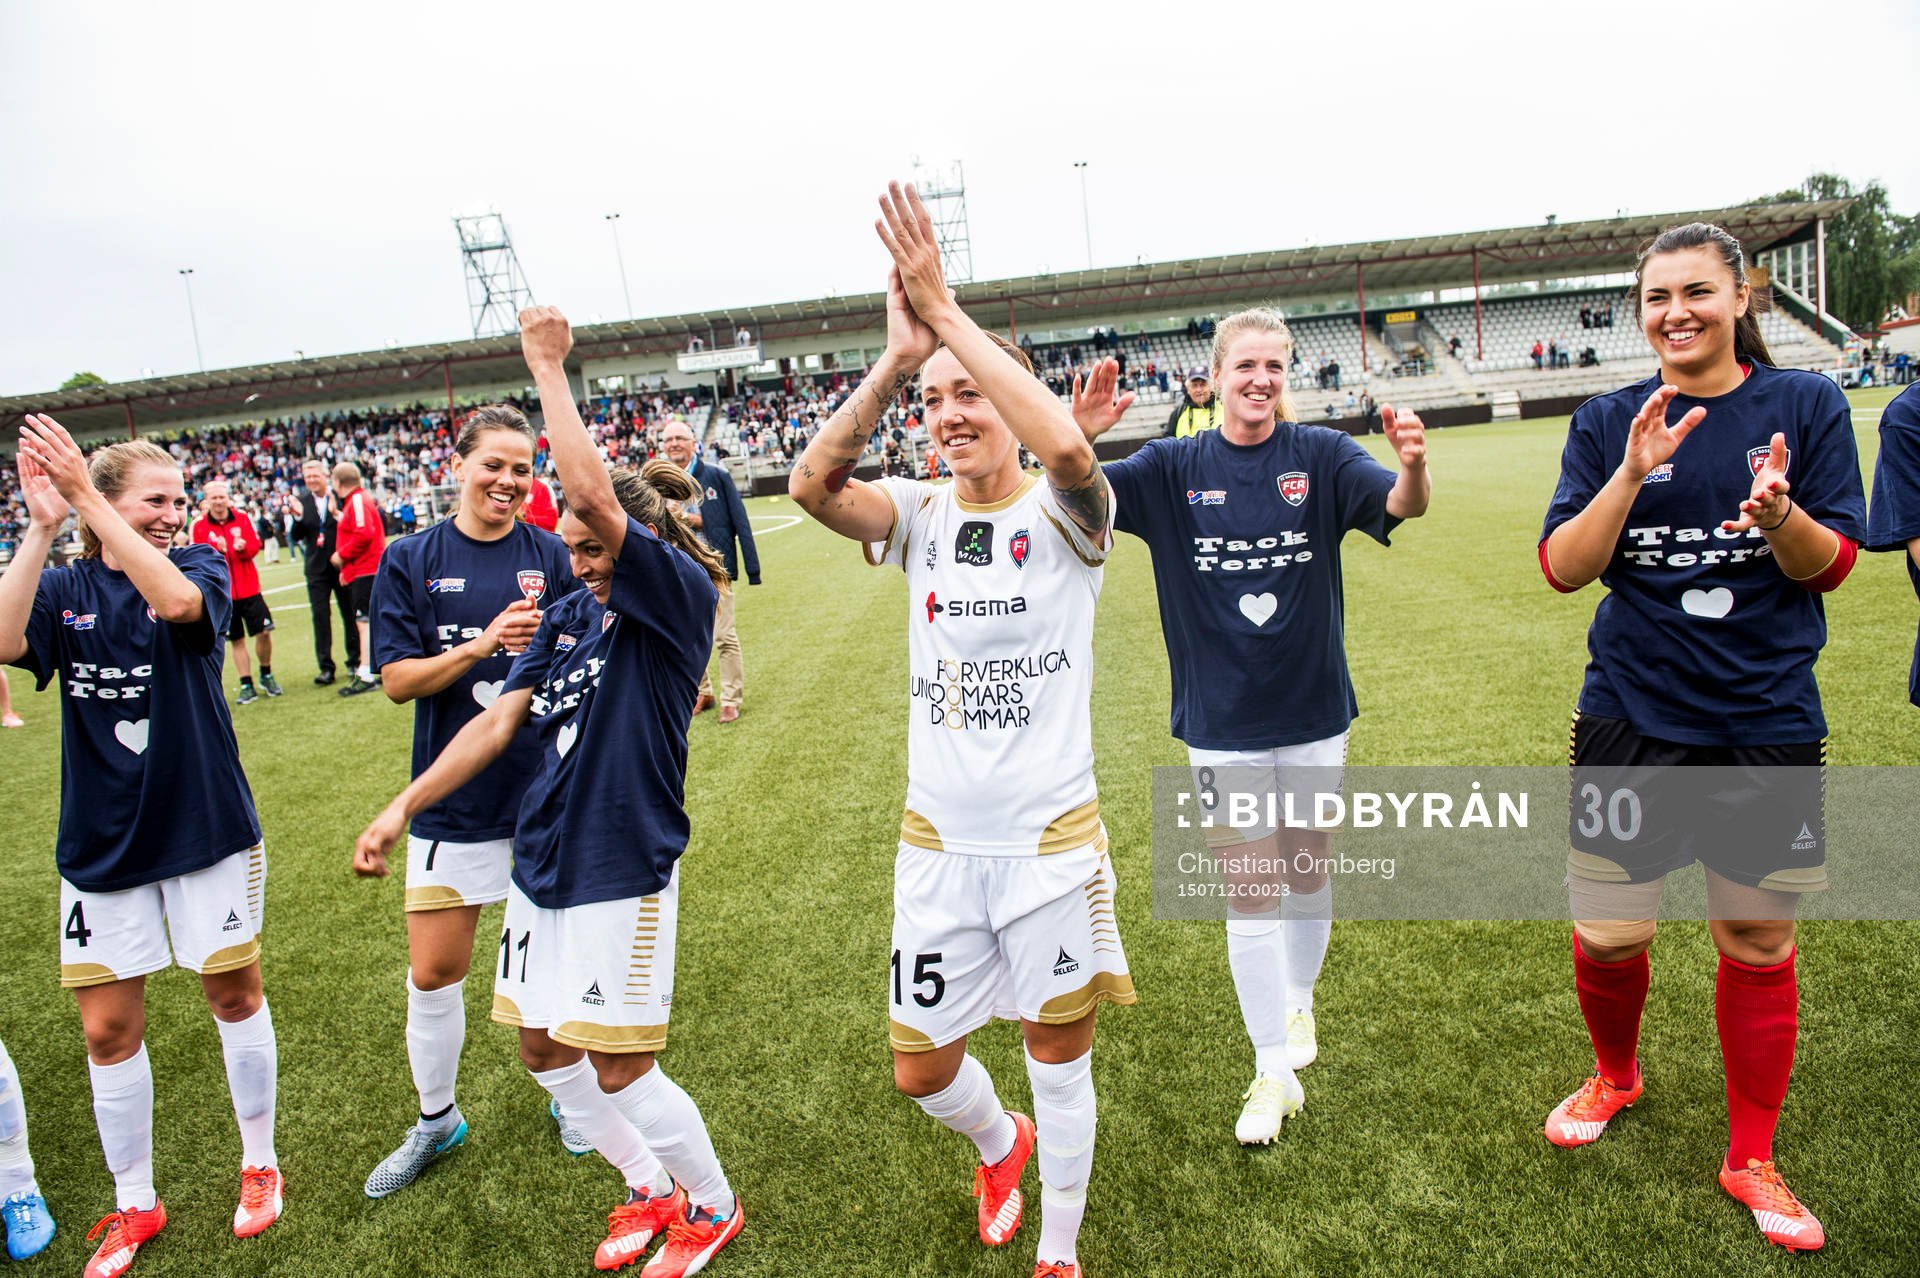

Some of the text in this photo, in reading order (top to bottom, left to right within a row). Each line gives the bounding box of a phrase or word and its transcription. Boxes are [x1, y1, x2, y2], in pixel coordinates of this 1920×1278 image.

[1282, 479, 1305, 491] FCR
[1194, 530, 1309, 553] Tack
[1194, 550, 1313, 571] Terre
[1623, 544, 1771, 567] Terre
[522, 577, 545, 587] FCR
[436, 624, 484, 640] Ta
[71, 661, 153, 679] Tac
[931, 705, 1031, 730] DÖMMAR
[1198, 766, 1220, 810] 8
[1578, 783, 1642, 841] 30
[1791, 840, 1817, 850] SELECT
[65, 900, 92, 948] 4
[222, 922, 243, 932] SELECT
[500, 927, 531, 983] 11
[891, 948, 946, 1008] 15
[1052, 962, 1080, 977] SELECT
[581, 996, 606, 1006] SELECT
